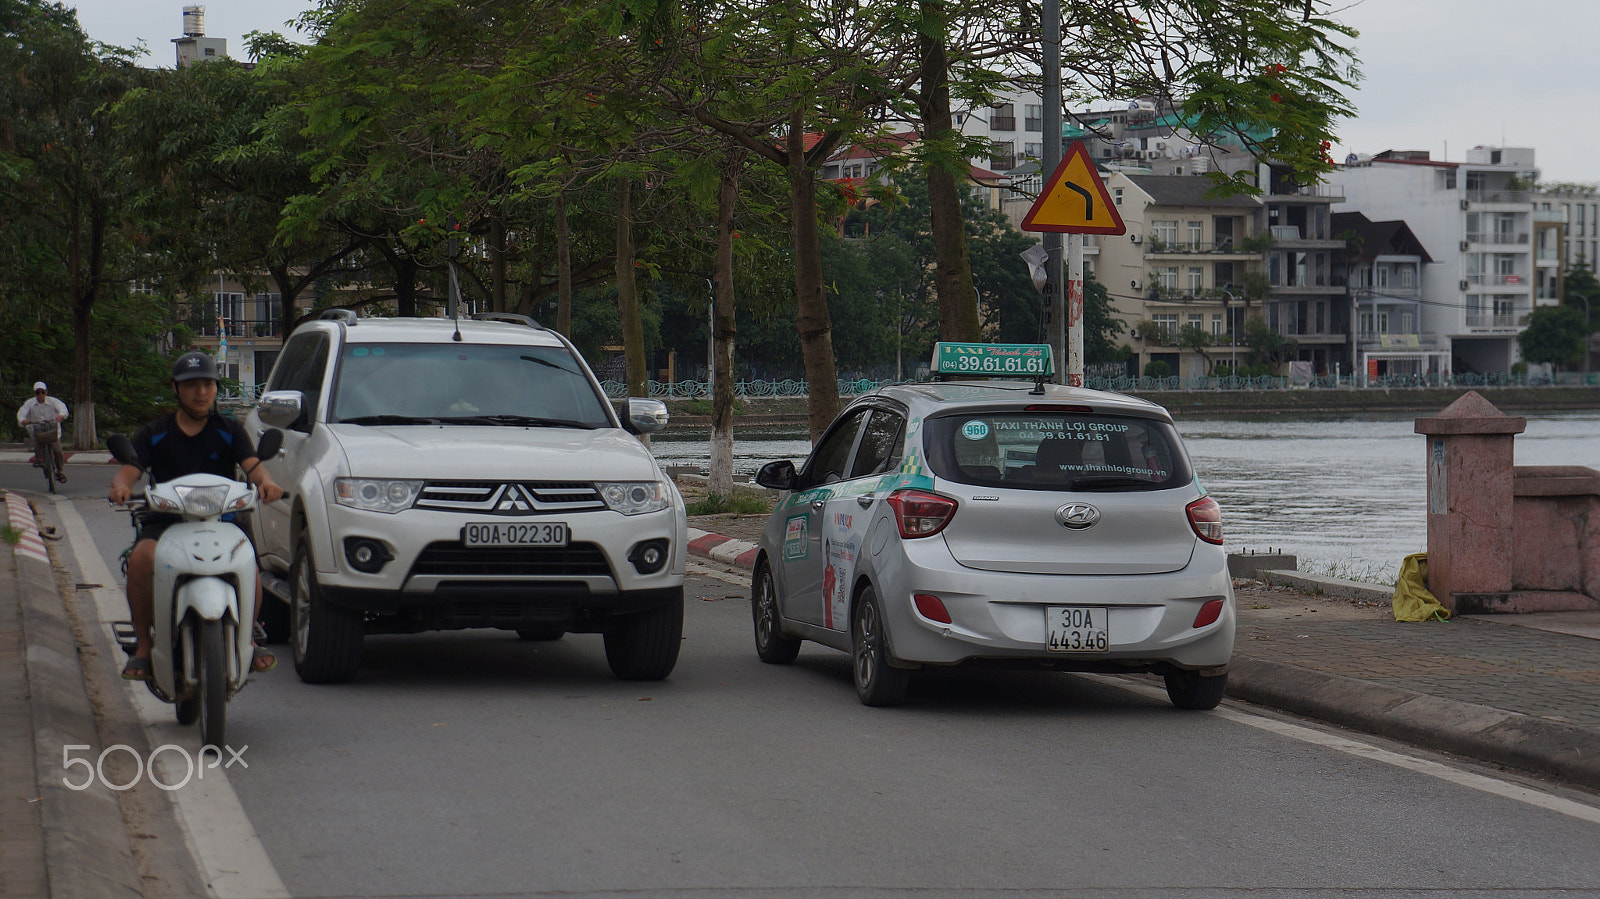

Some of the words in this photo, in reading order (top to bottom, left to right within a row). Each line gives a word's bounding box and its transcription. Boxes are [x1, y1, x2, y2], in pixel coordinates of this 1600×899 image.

[944, 346, 984, 355] TAXI
[942, 360, 958, 370] (04)
[958, 356, 1045, 372] 39.61.61.61
[966, 424, 986, 435] 960
[993, 422, 1020, 430] TAXI
[1088, 422, 1129, 433] GROUP
[1059, 463, 1167, 477] www.thanhloigroup.vn
[469, 525, 564, 544] 90A-022.30
[1061, 609, 1093, 629] 30A
[1049, 630, 1107, 650] 443.46
